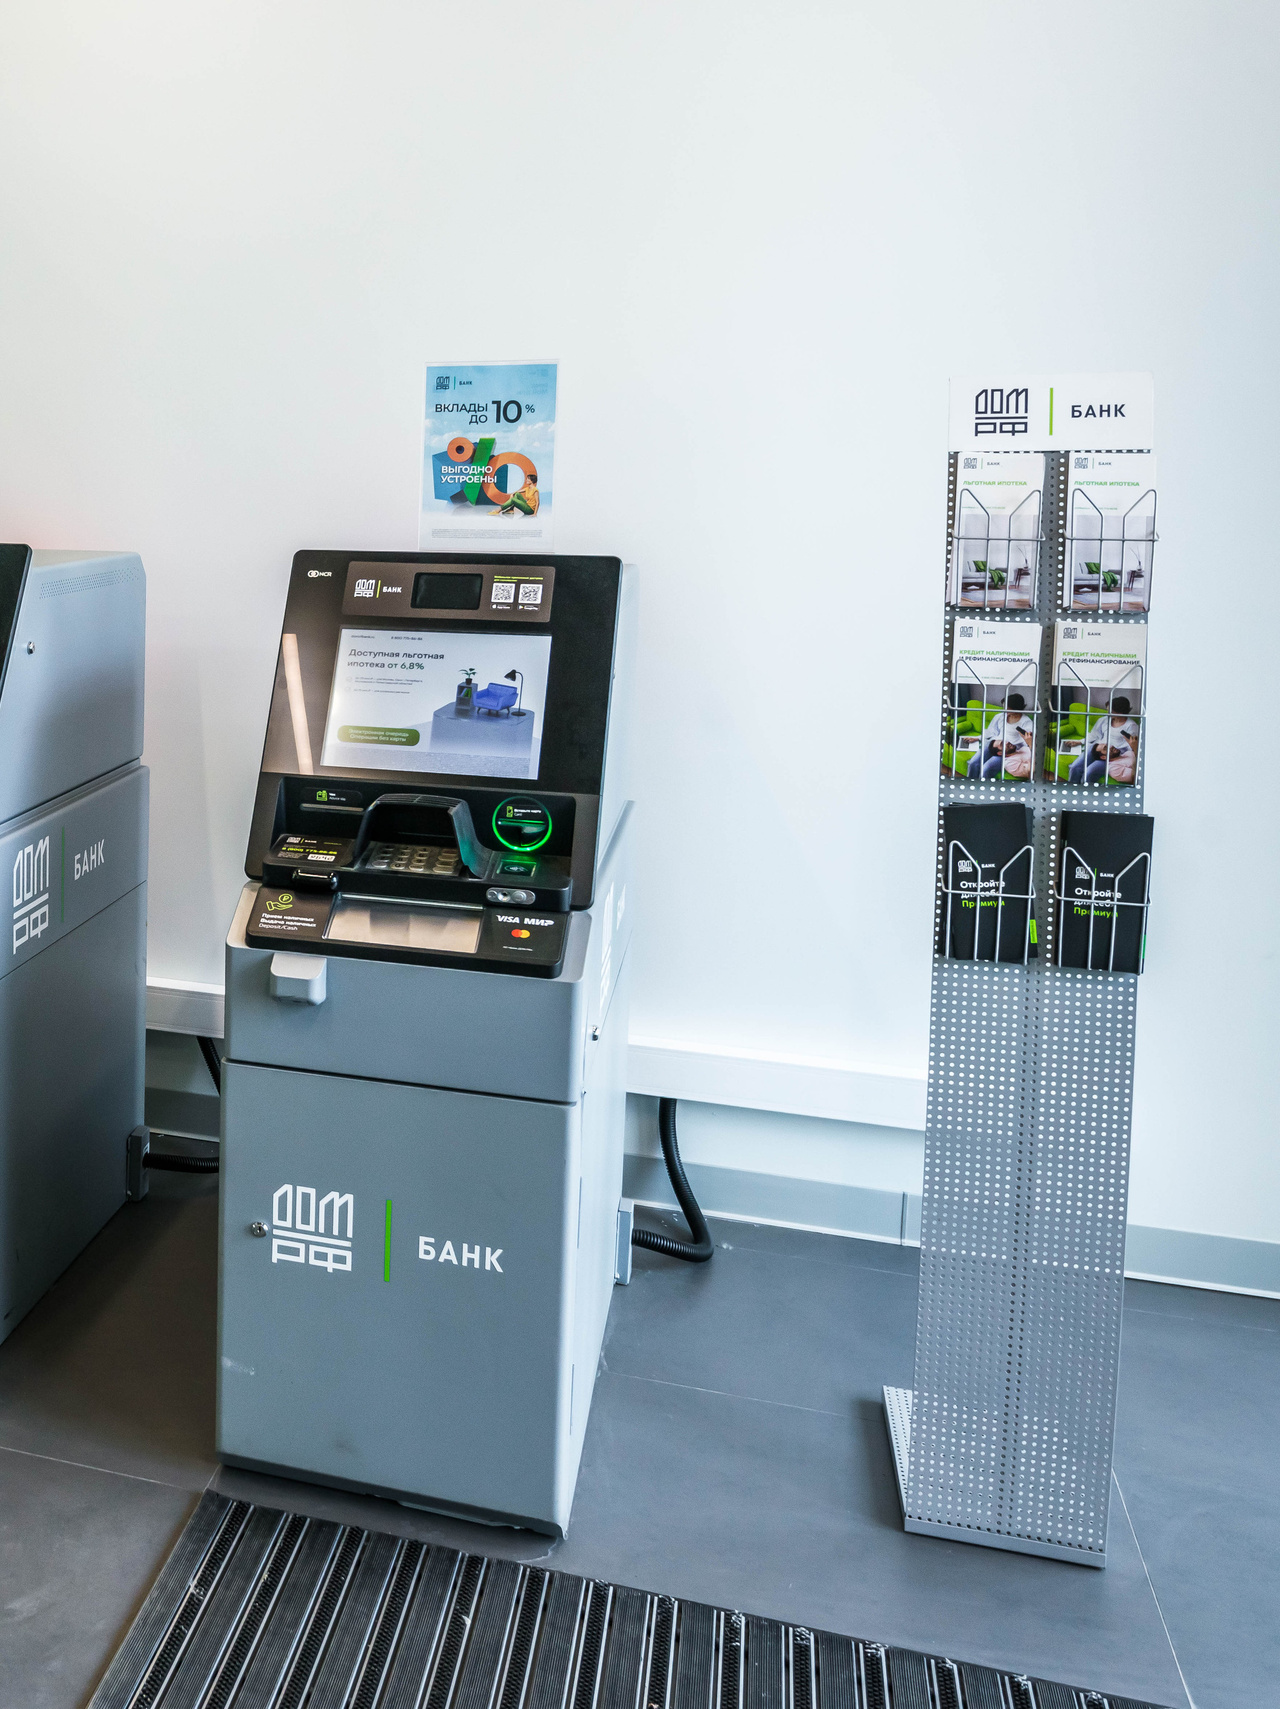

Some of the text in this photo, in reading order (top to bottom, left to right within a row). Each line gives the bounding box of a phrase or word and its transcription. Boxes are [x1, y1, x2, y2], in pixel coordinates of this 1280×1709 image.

[435, 403, 488, 413] ВКЛАДЫ
[975, 388, 1029, 415] ДОМ
[1071, 403, 1126, 418] БАНК
[469, 414, 488, 425] ДО
[974, 421, 1028, 437] РФ
[441, 465, 493, 474] ВЫГОДНО
[441, 475, 497, 483] УСТРОЕНЫ
[348, 649, 445, 660] Доступная льготная
[74, 838, 105, 881] БАНК
[13, 835, 50, 908] ДОМ
[962, 900, 1005, 909] Прмиум
[496, 914, 520, 923] VISA
[1074, 906, 1118, 918] Прмиу
[524, 917, 555, 926] МИР
[13, 904, 49, 955] РФ
[272, 1183, 354, 1238] ДОМ
[272, 1238, 352, 1273] РФ
[418, 1235, 504, 1273] БАНК
